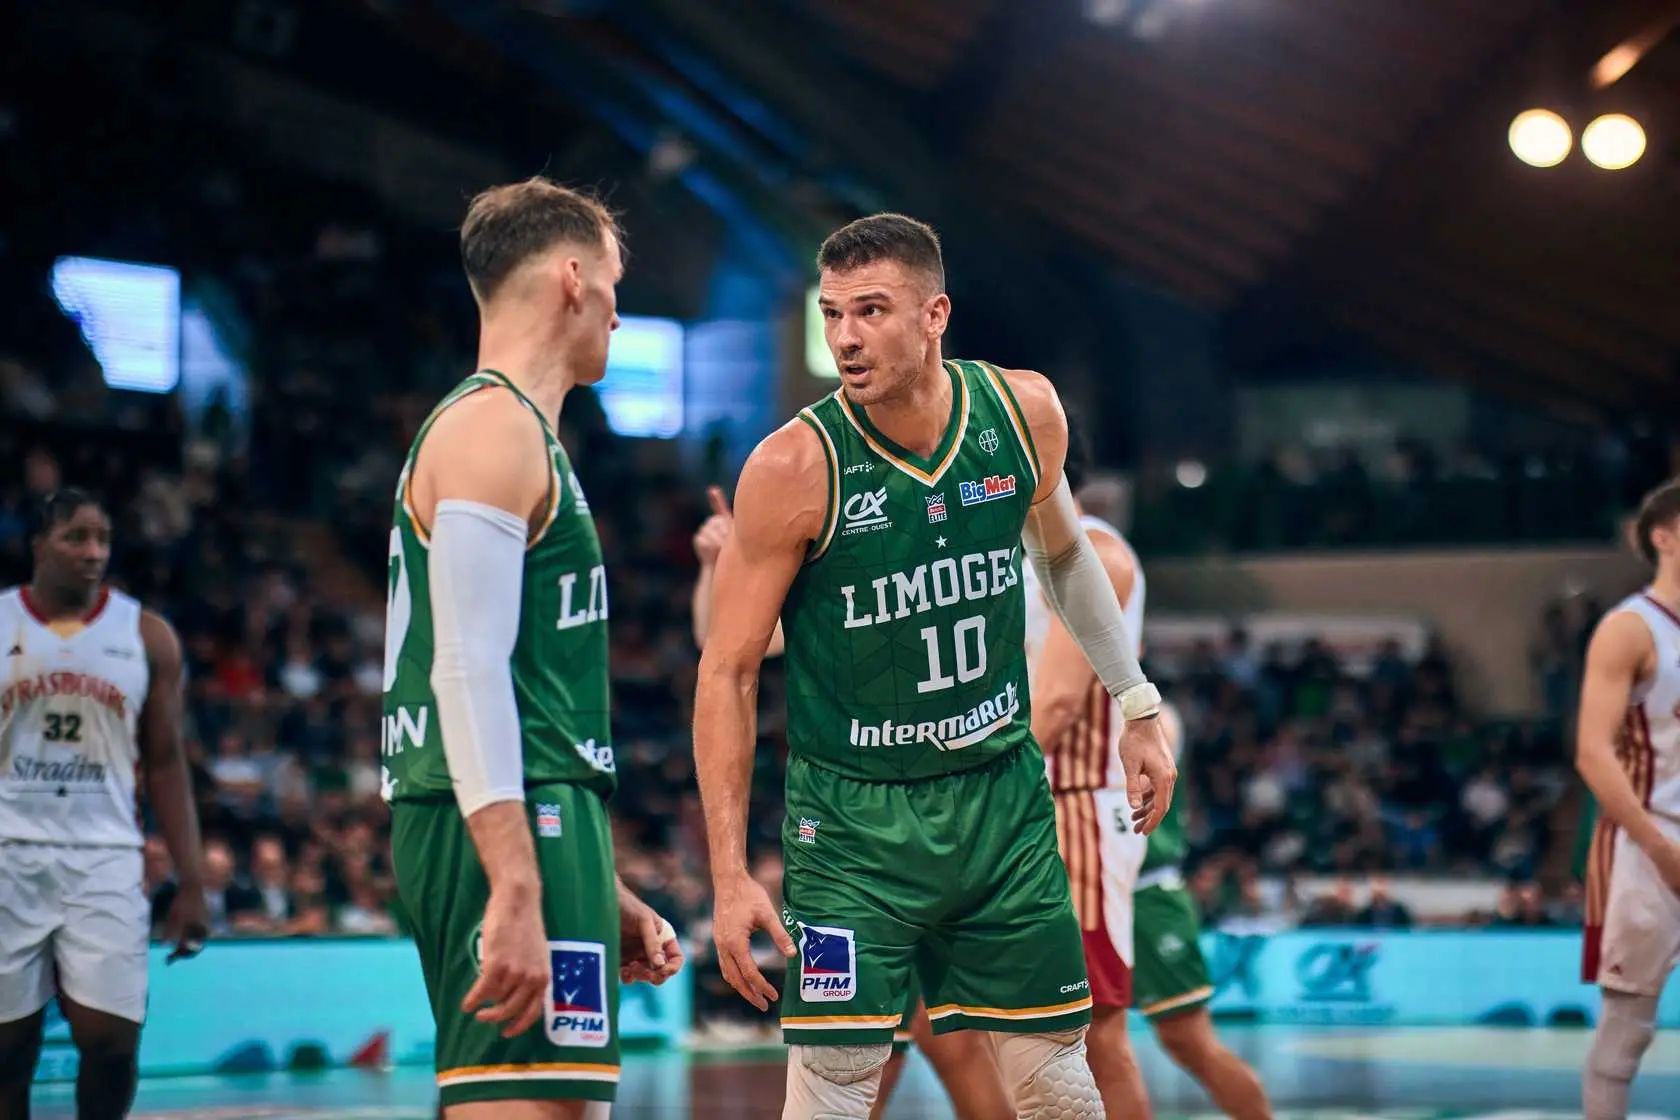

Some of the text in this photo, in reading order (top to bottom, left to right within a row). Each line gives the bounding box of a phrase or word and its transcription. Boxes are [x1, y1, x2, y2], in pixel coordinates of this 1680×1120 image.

[959, 474, 1016, 504] BigMat
[929, 511, 947, 522] ELITE
[841, 521, 894, 536] CENTRE OUEST
[841, 546, 1018, 629] LIMOGES
[917, 615, 987, 694] 10
[43, 713, 82, 742] 32
[802, 976, 851, 990] PHM
[1060, 980, 1085, 993] CRAFT
[552, 1016, 604, 1031] PHM
